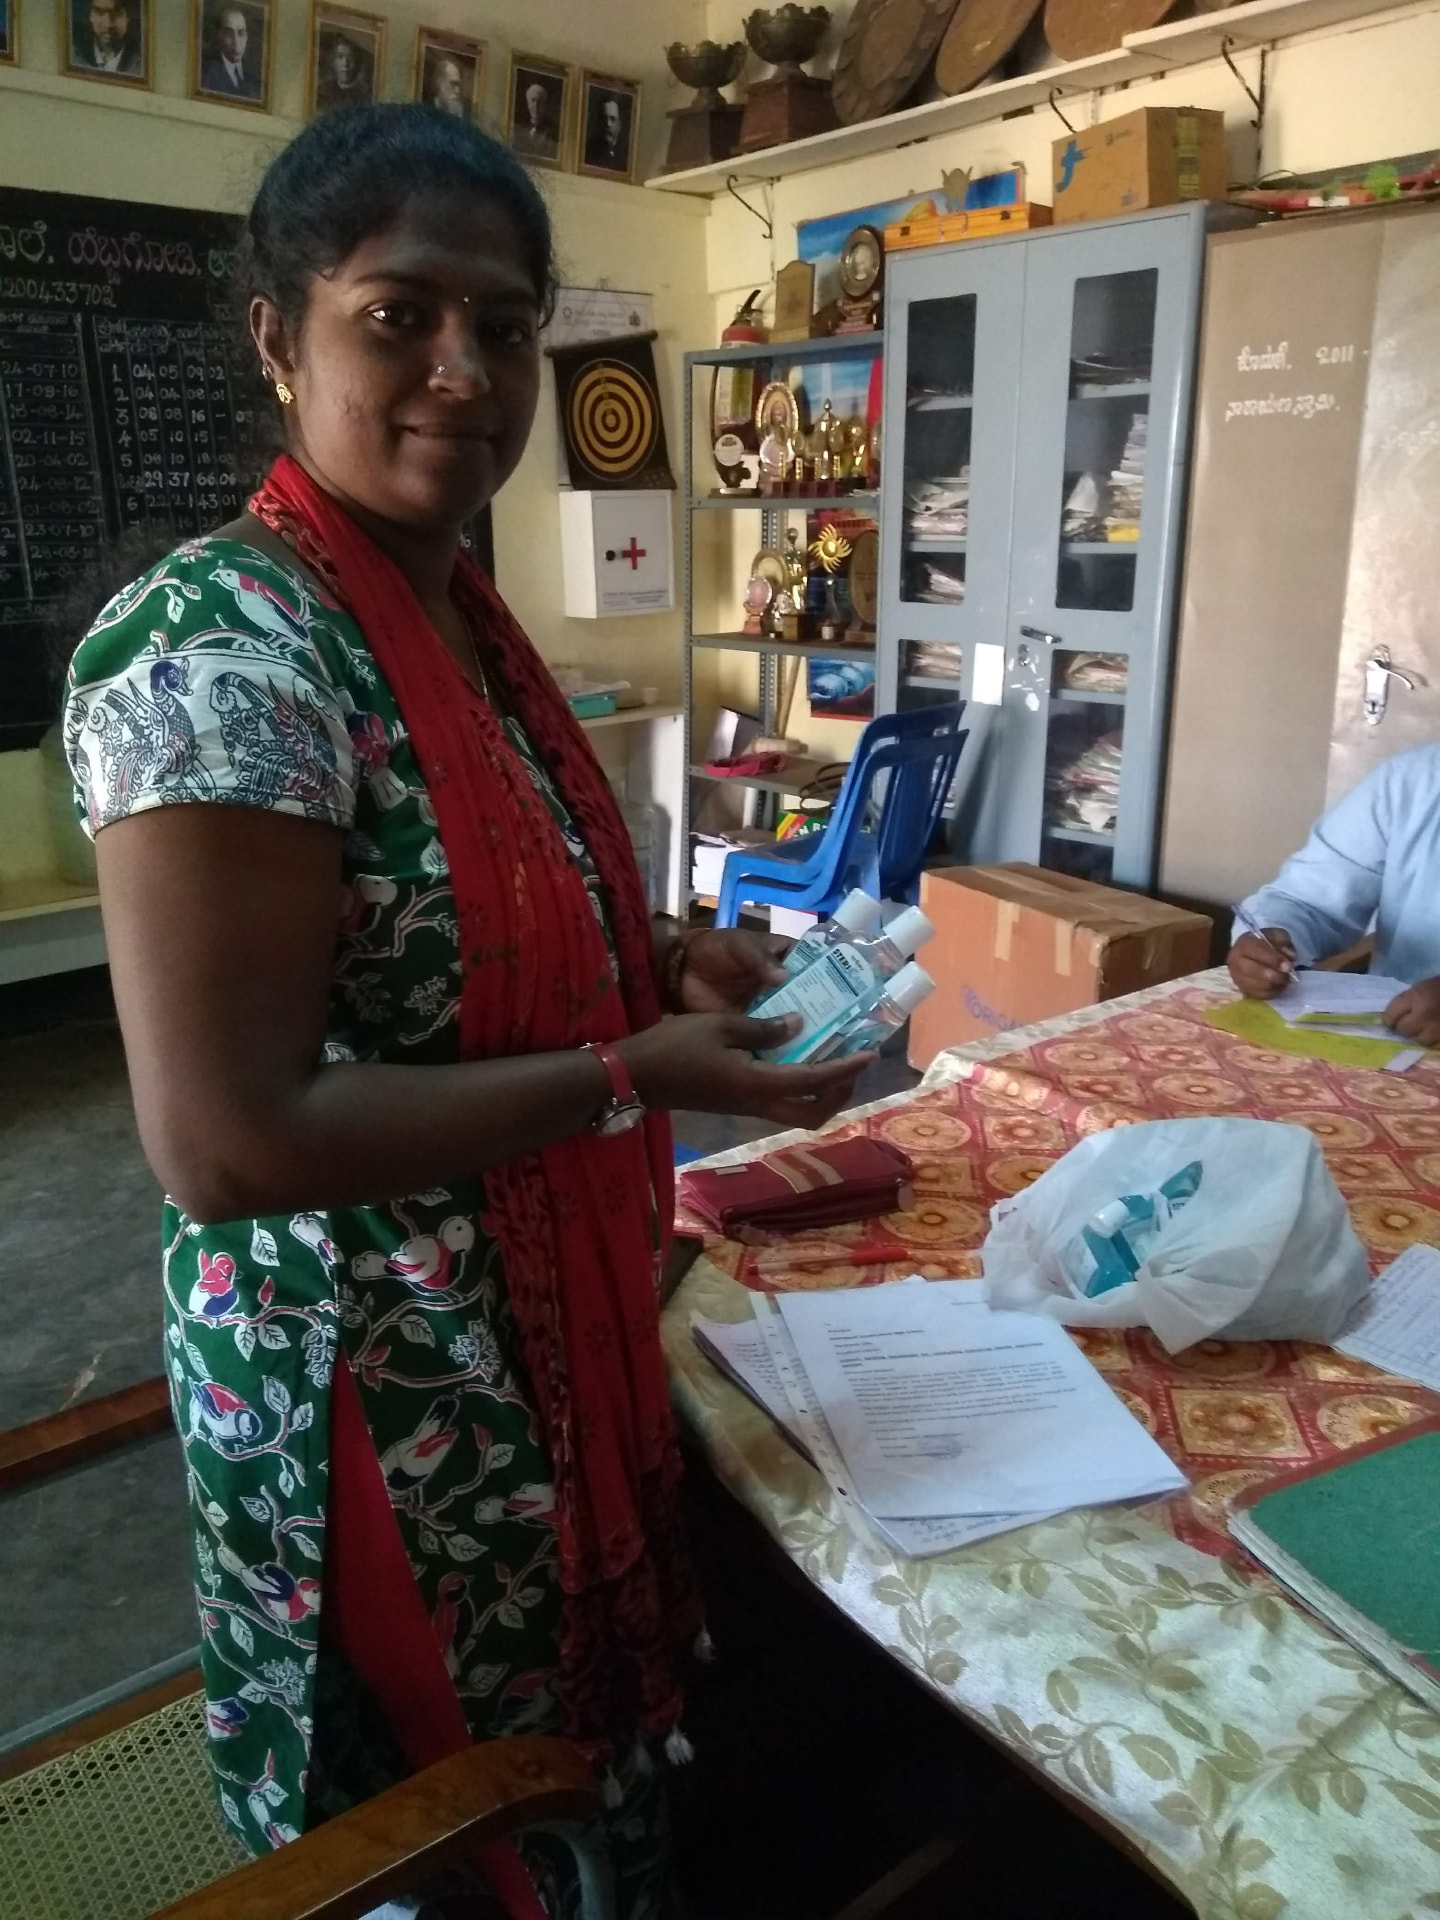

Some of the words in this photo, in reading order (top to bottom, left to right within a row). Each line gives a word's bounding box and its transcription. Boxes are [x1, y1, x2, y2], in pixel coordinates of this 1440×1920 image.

[159, 365, 179, 380] 05
[115, 408, 129, 426] 3
[120, 453, 133, 468] 5
[127, 497, 138, 511] 6
